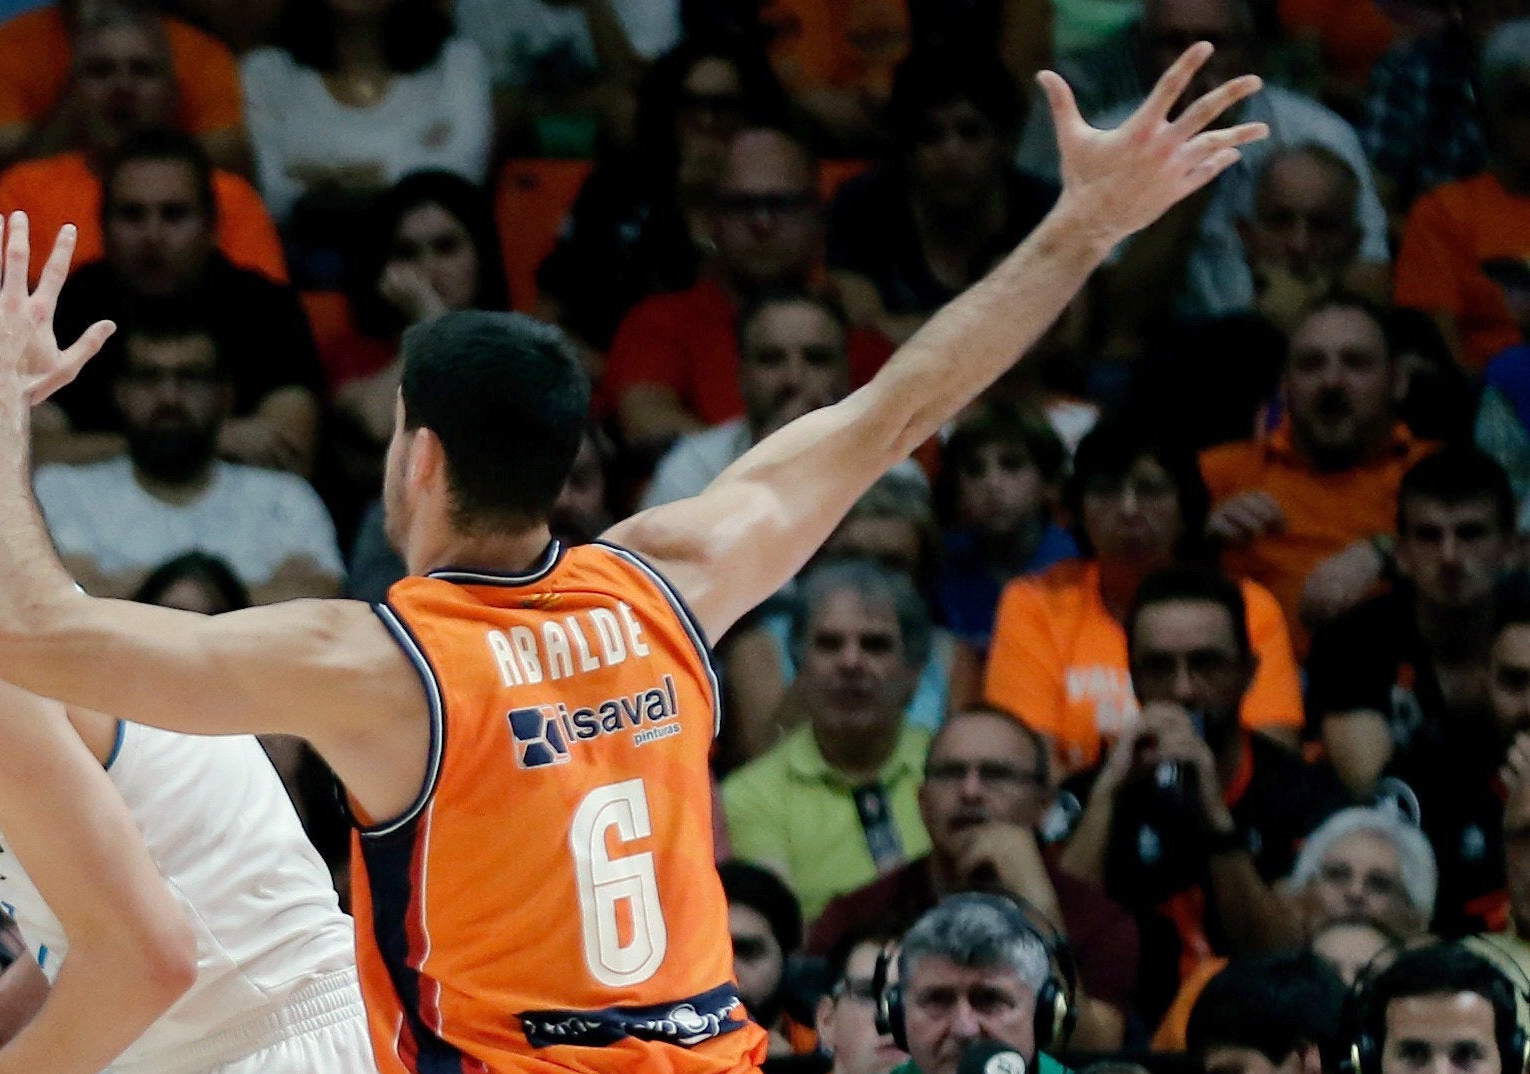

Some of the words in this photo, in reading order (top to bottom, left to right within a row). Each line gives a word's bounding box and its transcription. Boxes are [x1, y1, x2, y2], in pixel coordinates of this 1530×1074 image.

[486, 601, 650, 687] ABALDE
[557, 673, 678, 743] isaval
[633, 722, 682, 747] pinturas
[570, 777, 667, 988] 6
